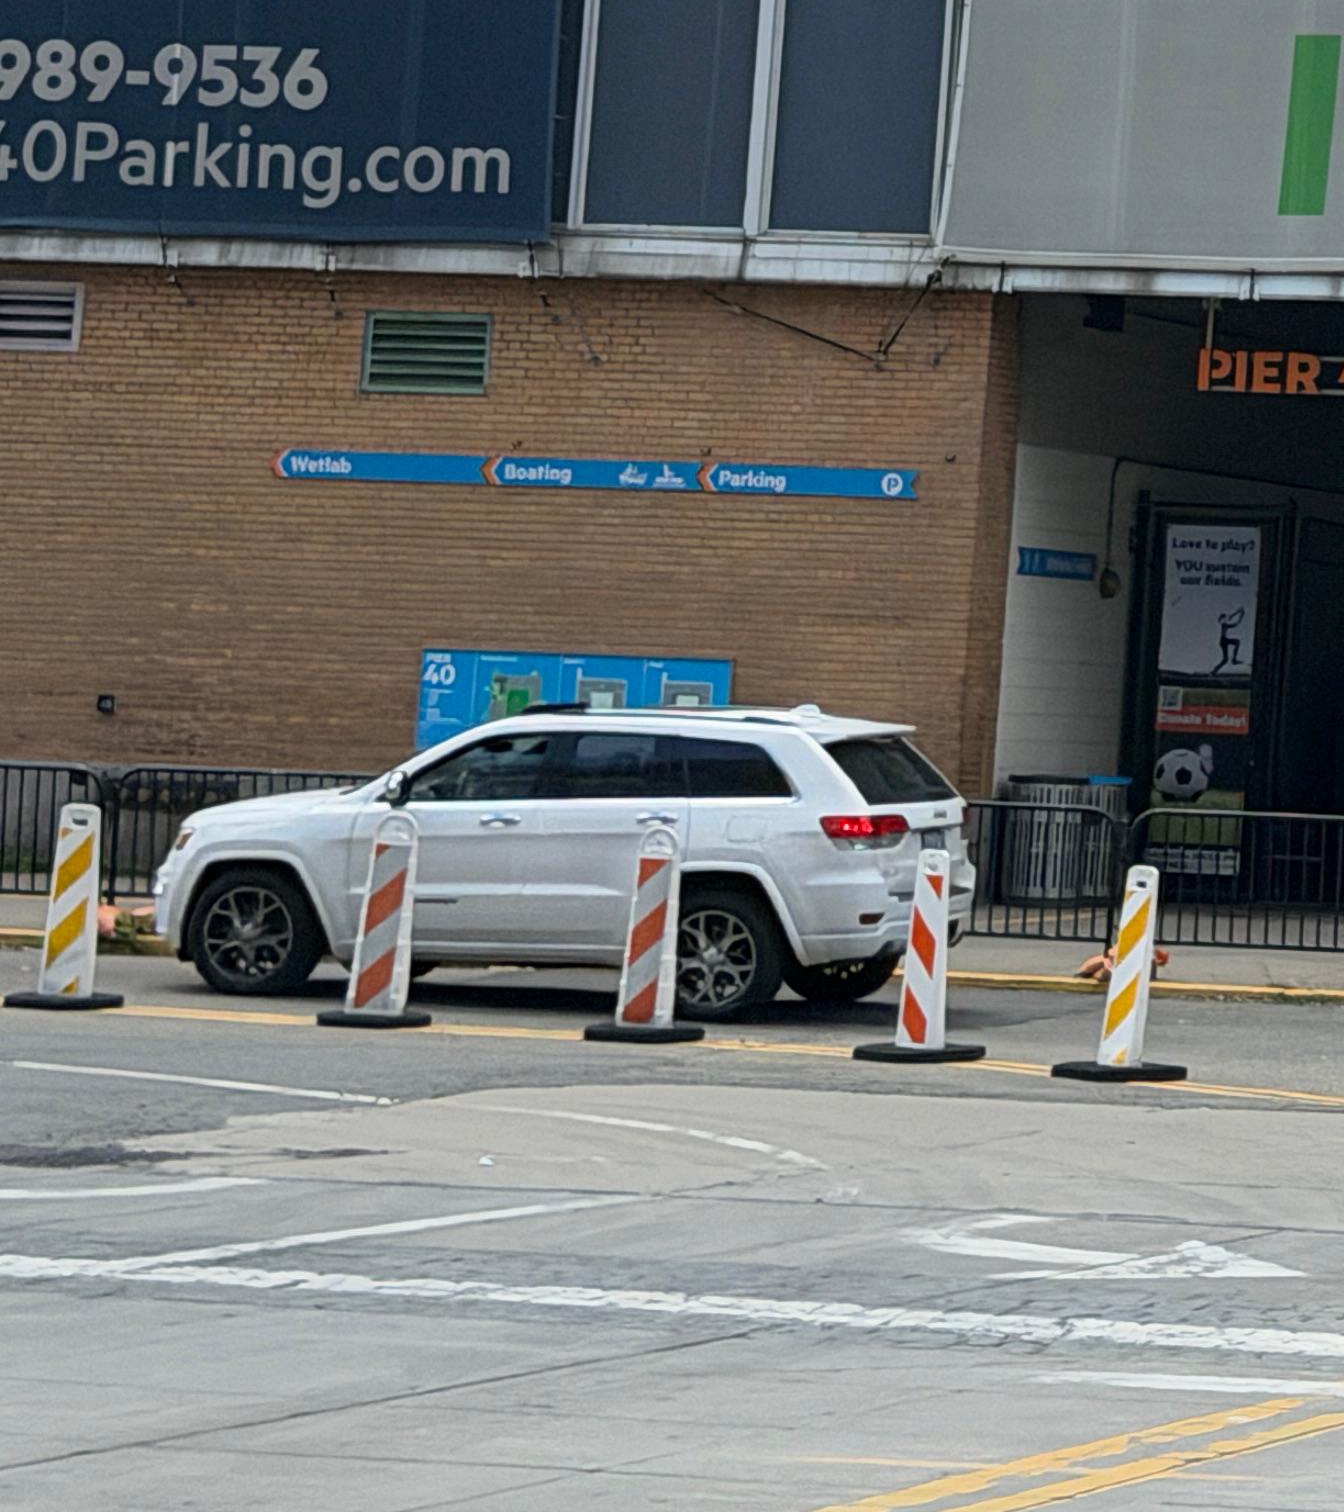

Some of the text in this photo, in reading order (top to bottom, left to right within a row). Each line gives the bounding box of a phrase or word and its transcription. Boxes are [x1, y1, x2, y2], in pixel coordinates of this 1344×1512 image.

[0, 39, 328, 110] 989-9536
[1197, 347, 1321, 395] PIER
[290, 453, 352, 476] Wetlab
[503, 462, 573, 485] Boating
[717, 469, 786, 491] Parking
[423, 663, 456, 686] 40
